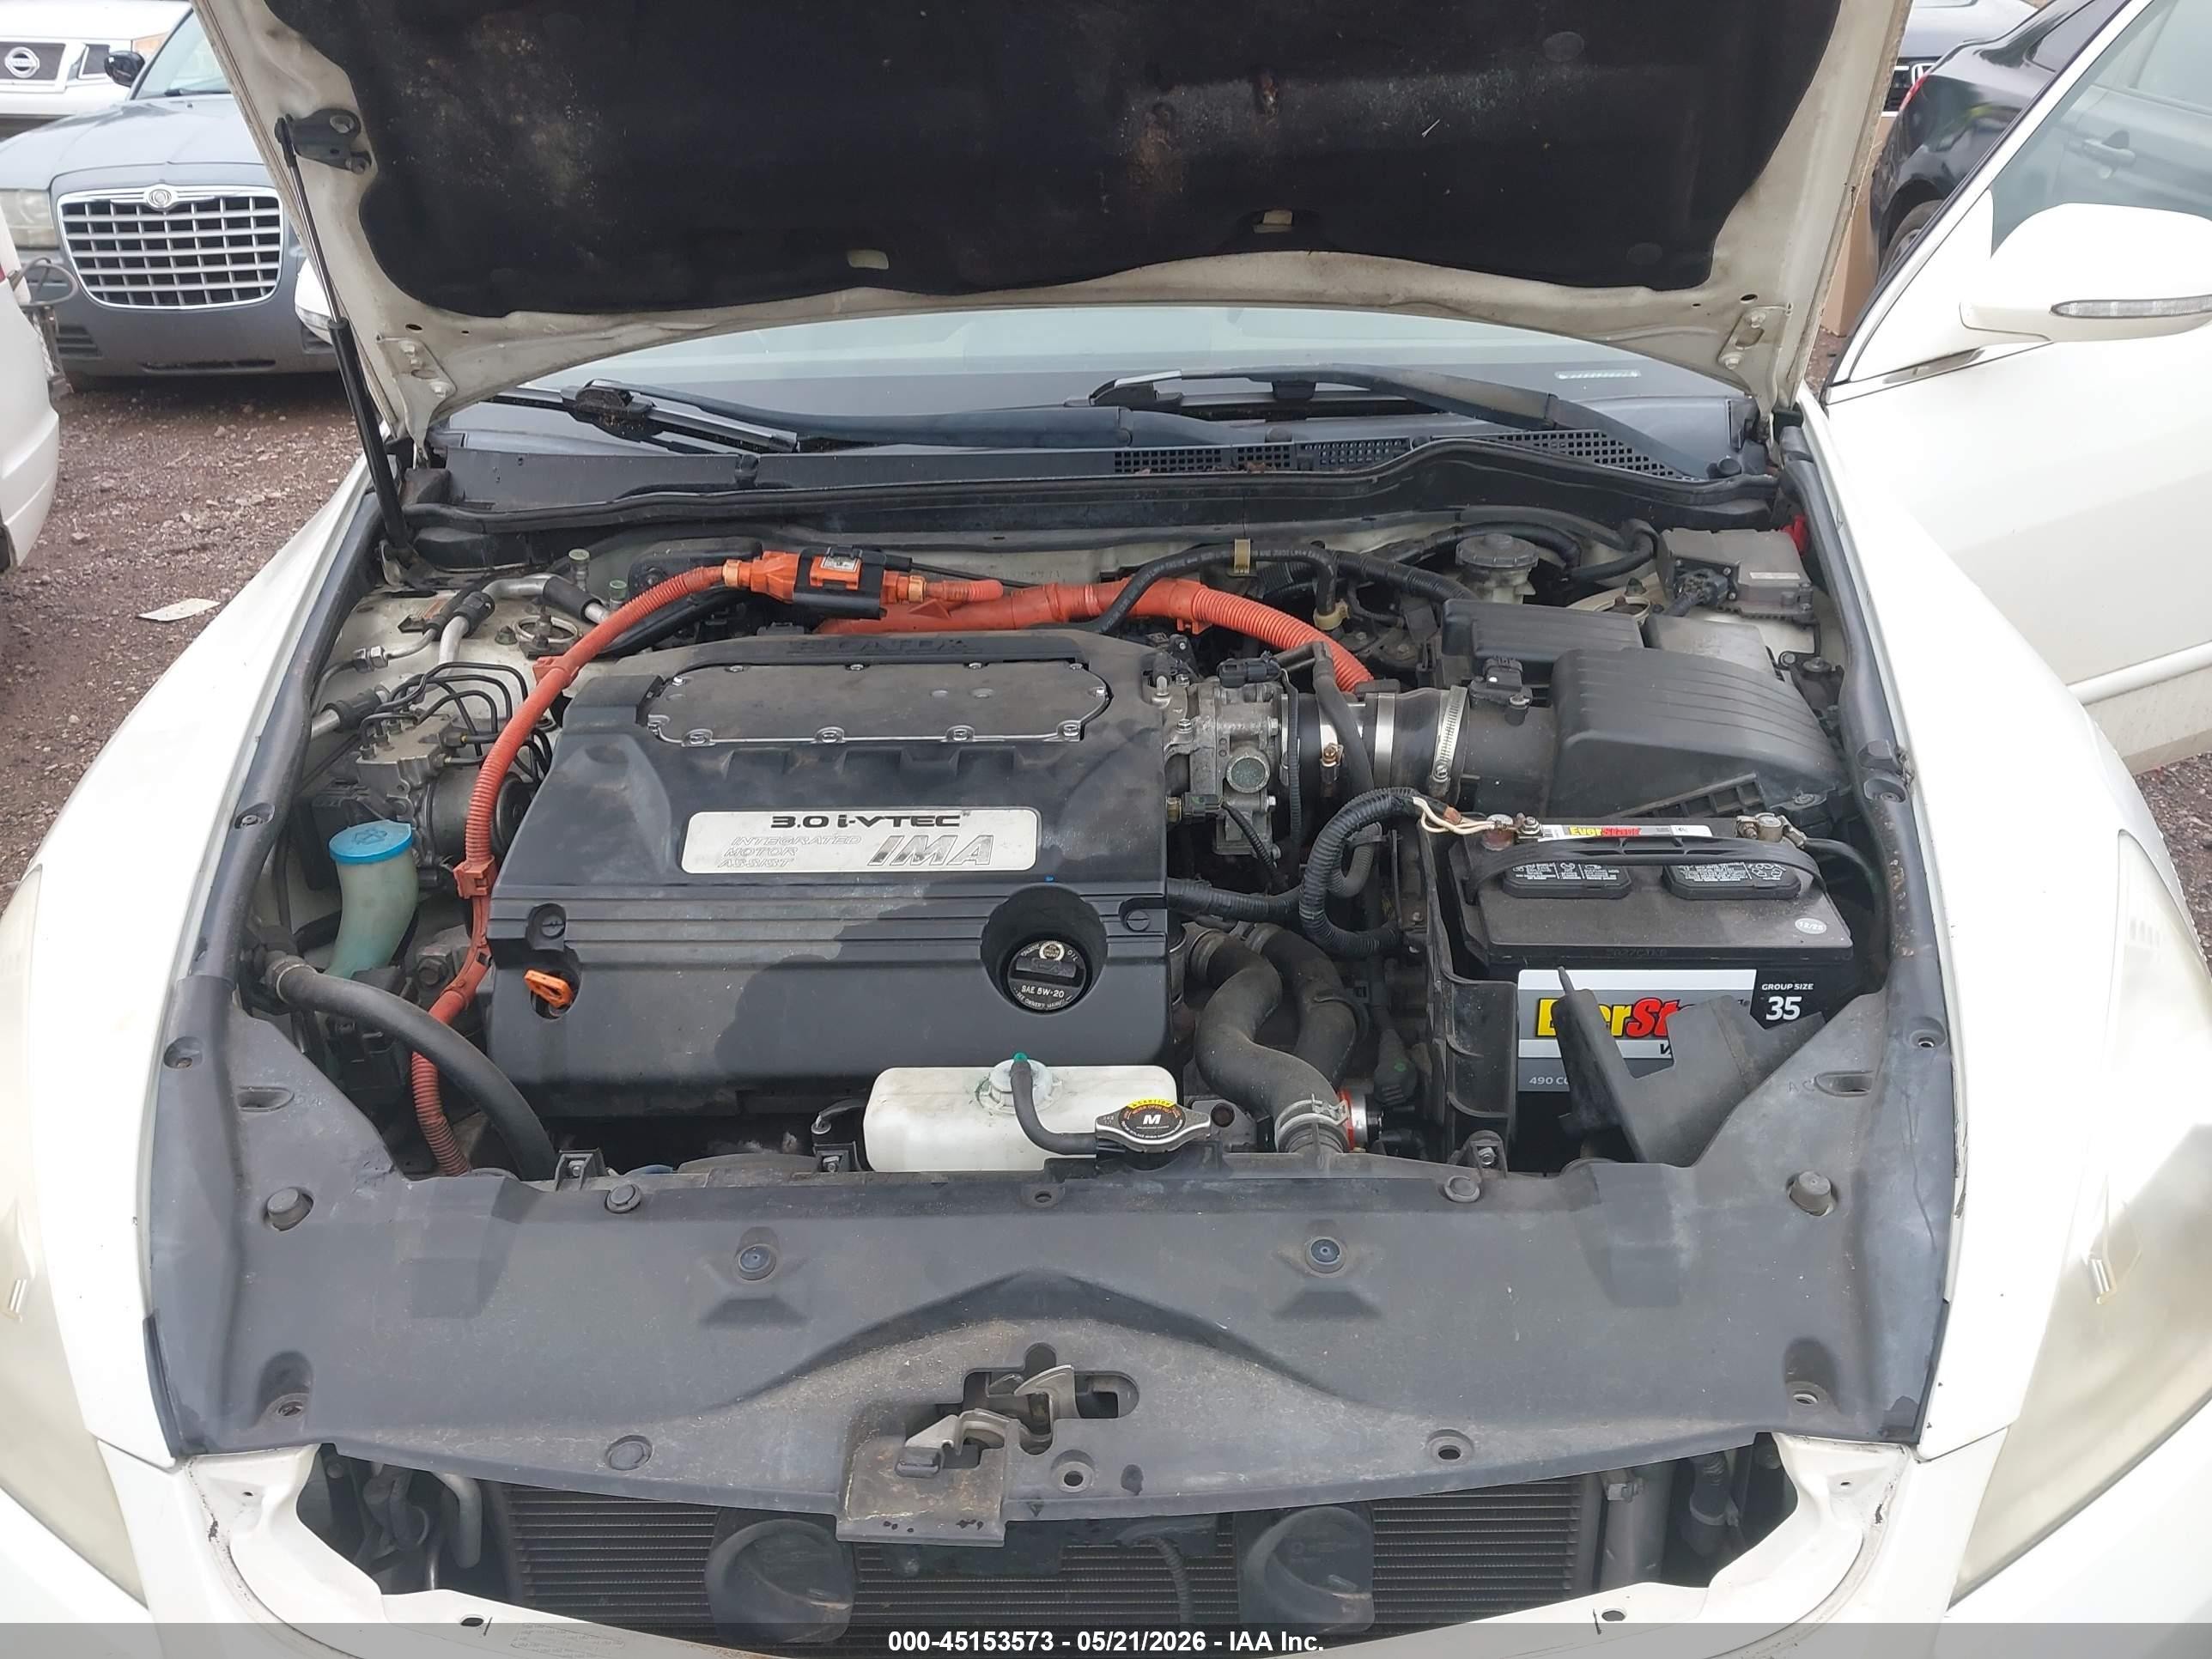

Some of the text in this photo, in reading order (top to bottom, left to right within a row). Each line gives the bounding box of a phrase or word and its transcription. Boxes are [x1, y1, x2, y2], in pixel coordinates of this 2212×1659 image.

[770, 813, 961, 829] 3.0 i-VTEC
[730, 835, 863, 846] INTEGRATED
[724, 847, 799, 857] MOTOR
[866, 835, 996, 866] IMA
[716, 857, 793, 868] ASSIST
[1066, 949, 1079, 962] OIL
[1021, 985, 1036, 994] SAE
[1761, 982, 1814, 991] GROUP SIZE
[1765, 996, 1802, 1022] 35
[1528, 1077, 1553, 1085] 490
[1142, 1114, 1162, 1125] M
